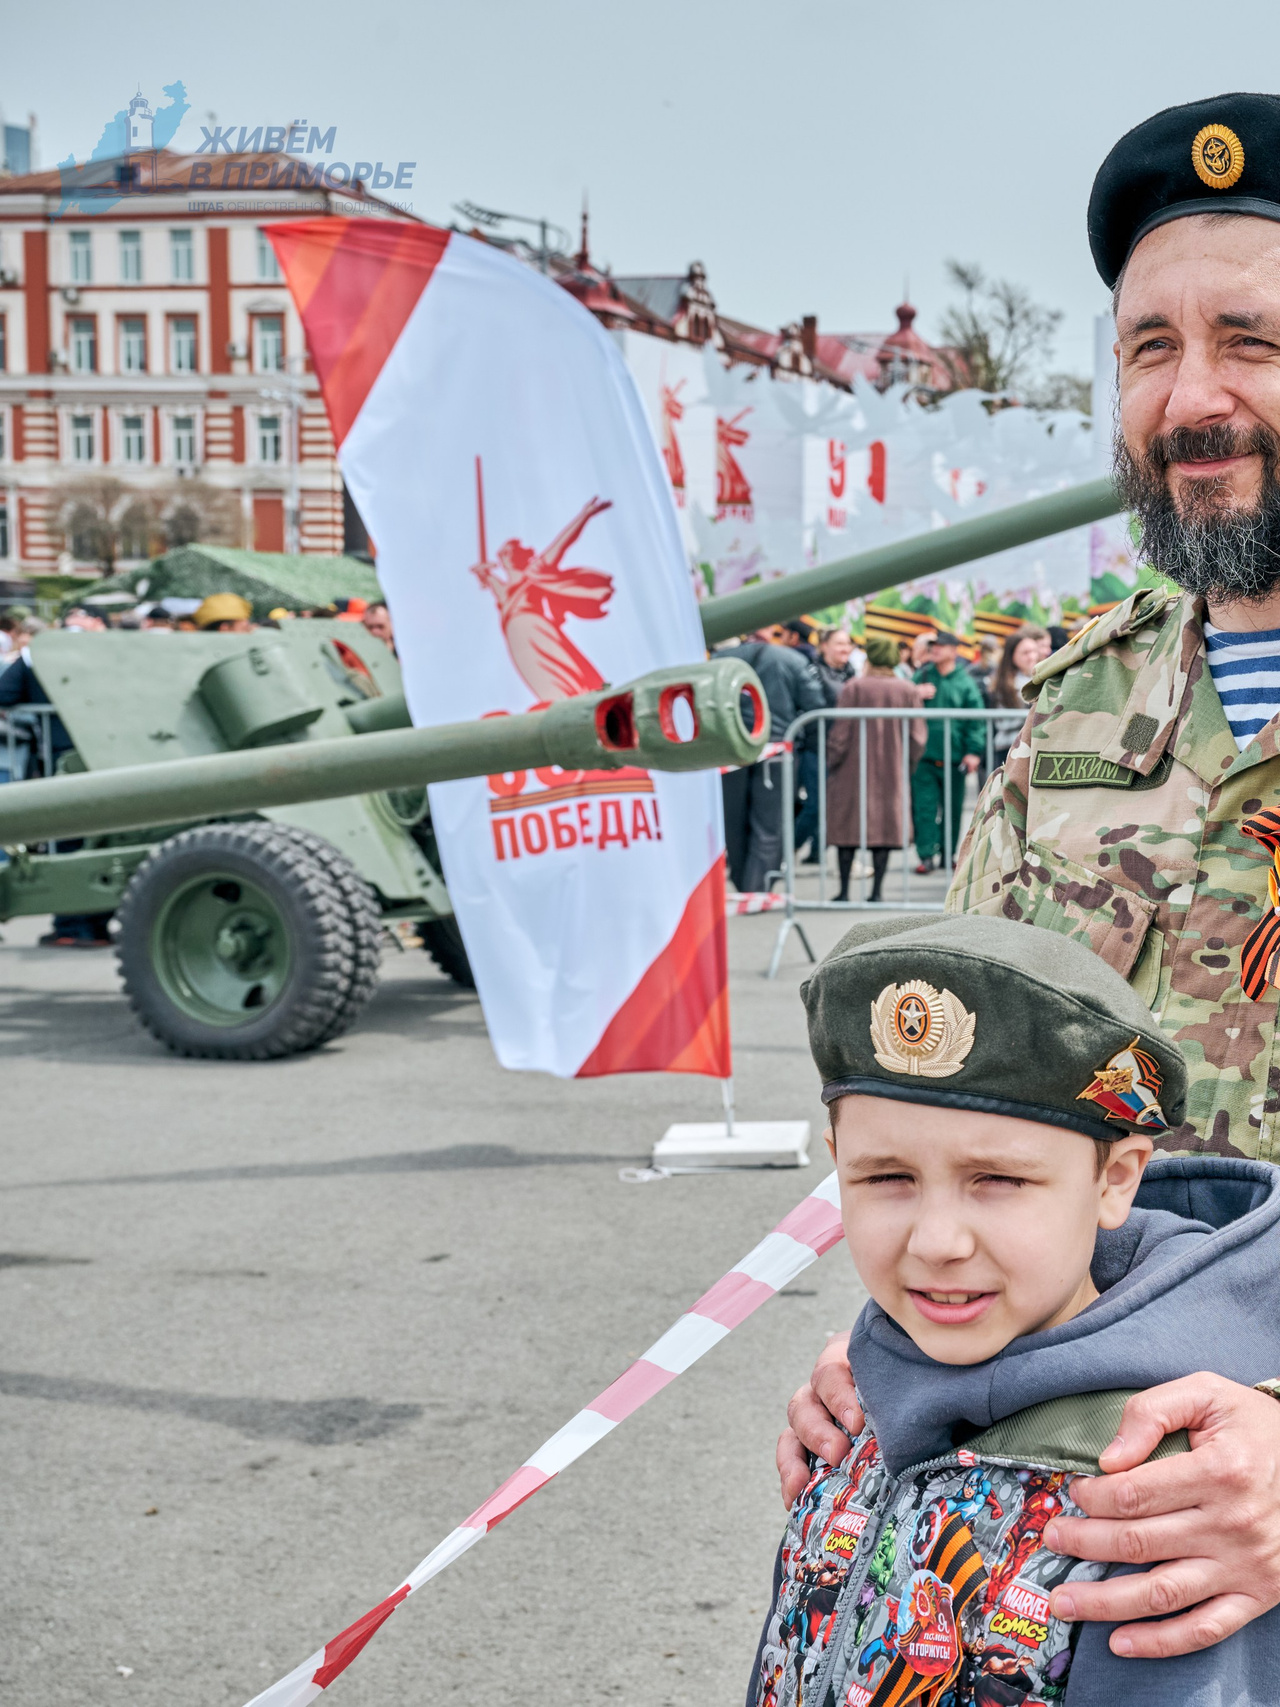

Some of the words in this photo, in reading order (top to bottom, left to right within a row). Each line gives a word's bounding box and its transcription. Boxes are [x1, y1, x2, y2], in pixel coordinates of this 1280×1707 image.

[490, 797, 662, 861] ПОБЕДА!
[834, 1511, 868, 1537] MARVE
[1002, 1585, 1050, 1623] MARVEL
[937, 1612, 950, 1634] Я
[989, 1612, 1049, 1642] COMICS
[909, 1642, 915, 1656] Я
[915, 1643, 951, 1660] ГОРЖУСЬ!
